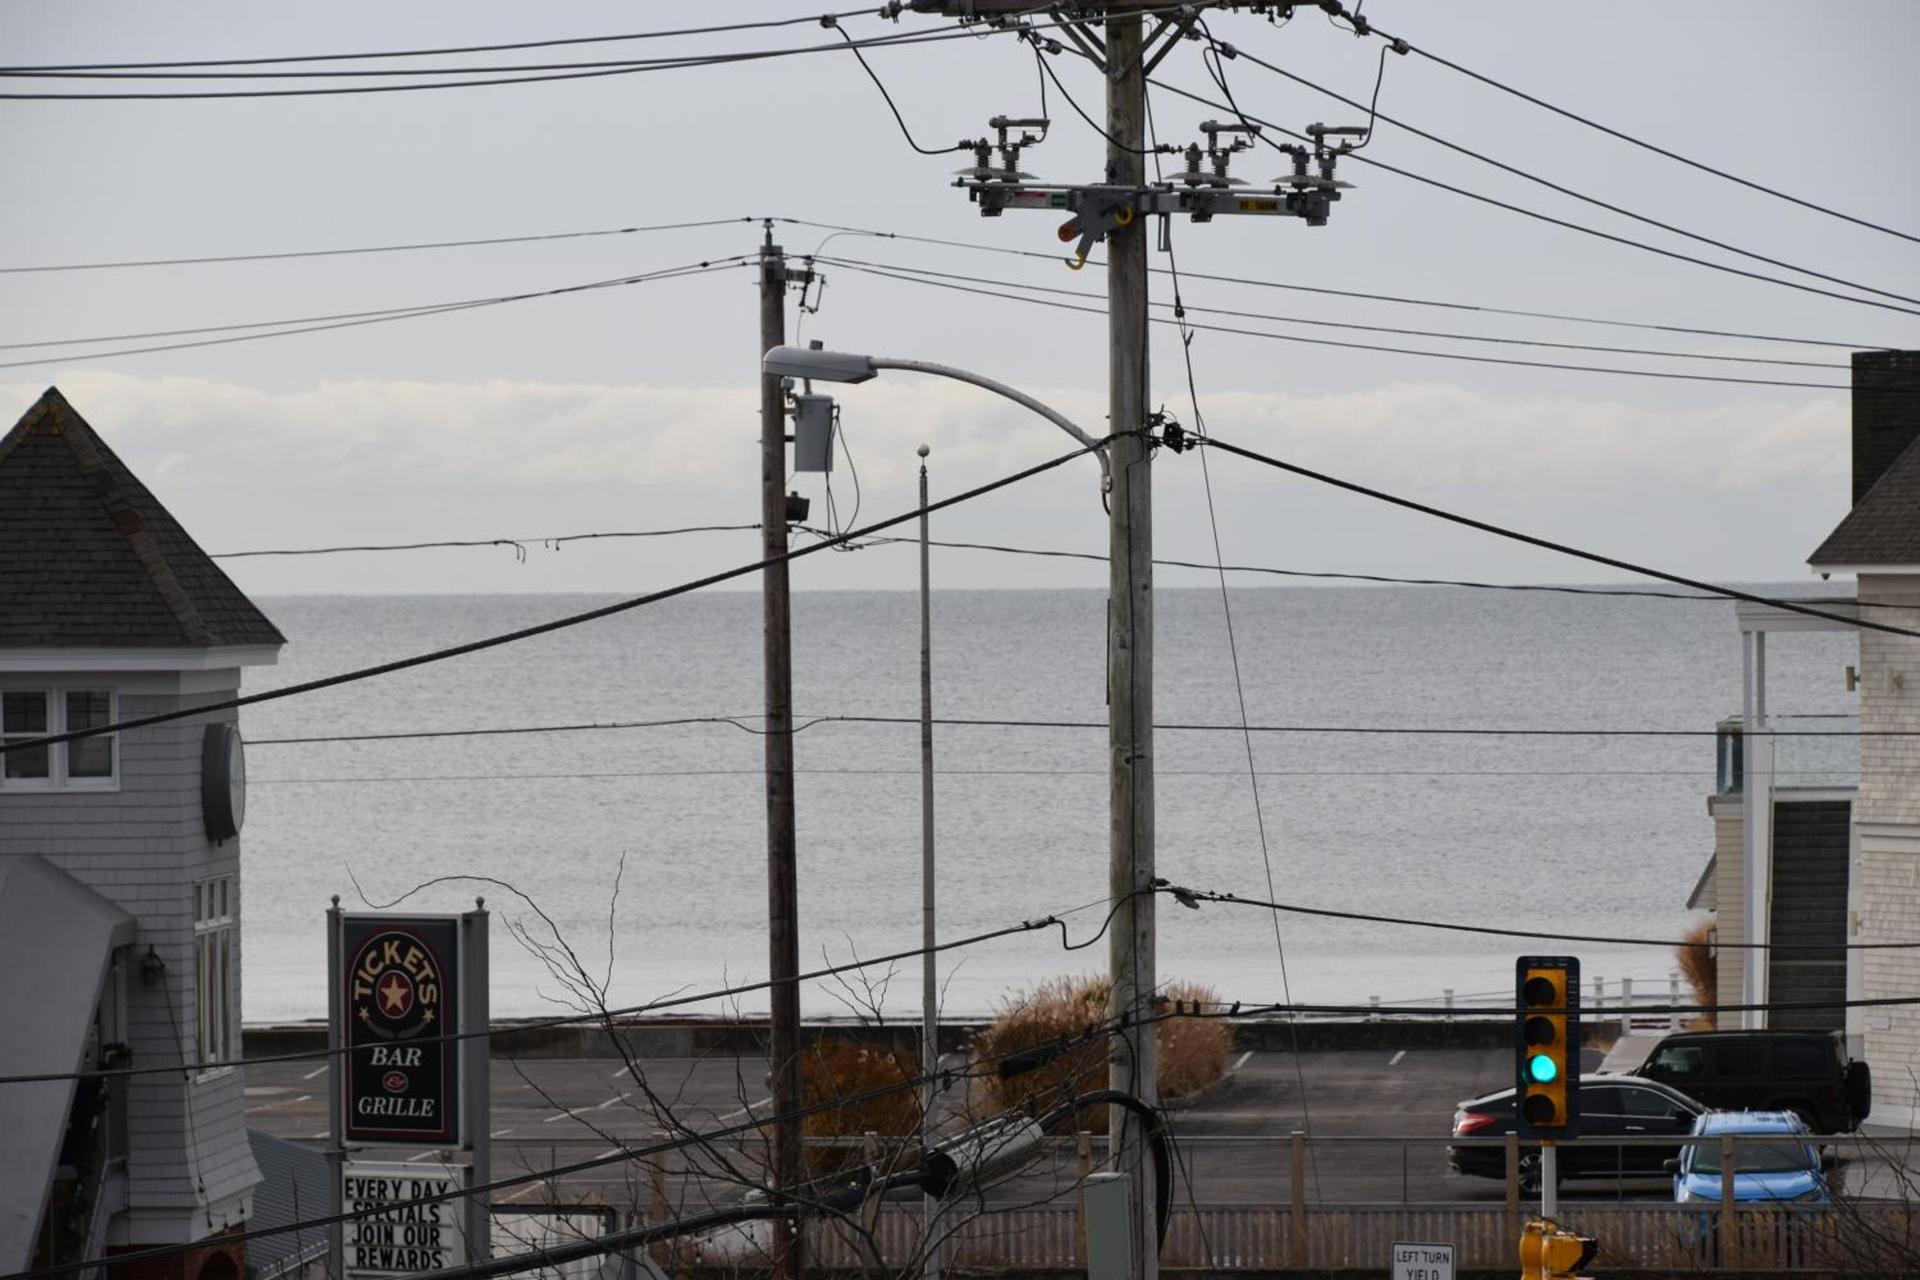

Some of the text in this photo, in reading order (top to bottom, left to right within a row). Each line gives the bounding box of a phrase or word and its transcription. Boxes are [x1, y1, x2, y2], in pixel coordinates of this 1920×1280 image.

[354, 940, 437, 1004] TICKETS
[370, 1047, 422, 1067] BAR
[358, 1096, 434, 1117] GRILLE
[345, 1178, 447, 1200] EVERY DAY
[352, 1224, 441, 1247] JOIN OUR
[356, 1247, 443, 1270] REWARDS
[1396, 1251, 1450, 1264] LEFT TURN
[1407, 1268, 1440, 1280] YIELD
